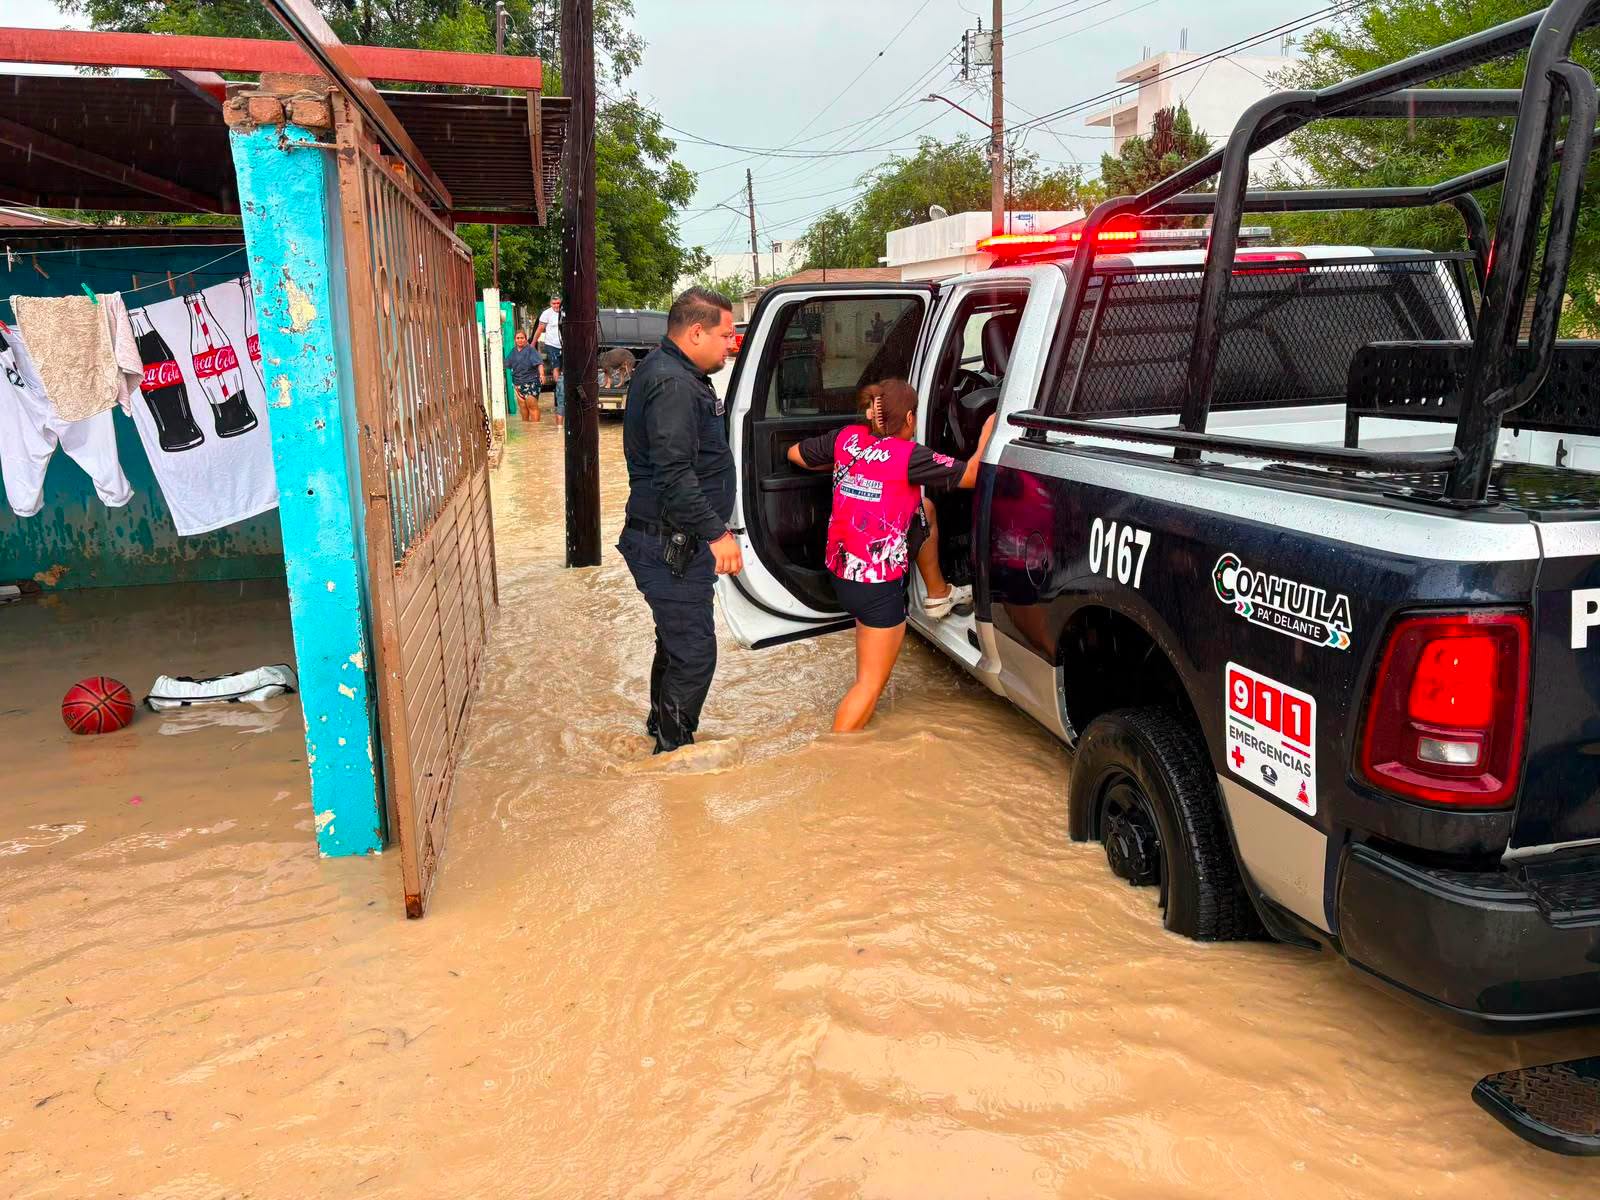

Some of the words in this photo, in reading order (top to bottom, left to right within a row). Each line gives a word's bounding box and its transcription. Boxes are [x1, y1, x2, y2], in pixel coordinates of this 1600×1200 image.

[143, 361, 180, 385] ca-Cola
[1089, 517, 1151, 589] 0167
[1213, 552, 1352, 632] COAHUILA
[1274, 613, 1321, 638] DELANTE
[1233, 679, 1302, 737] 911
[1229, 724, 1311, 778] EMERGENCIAS
